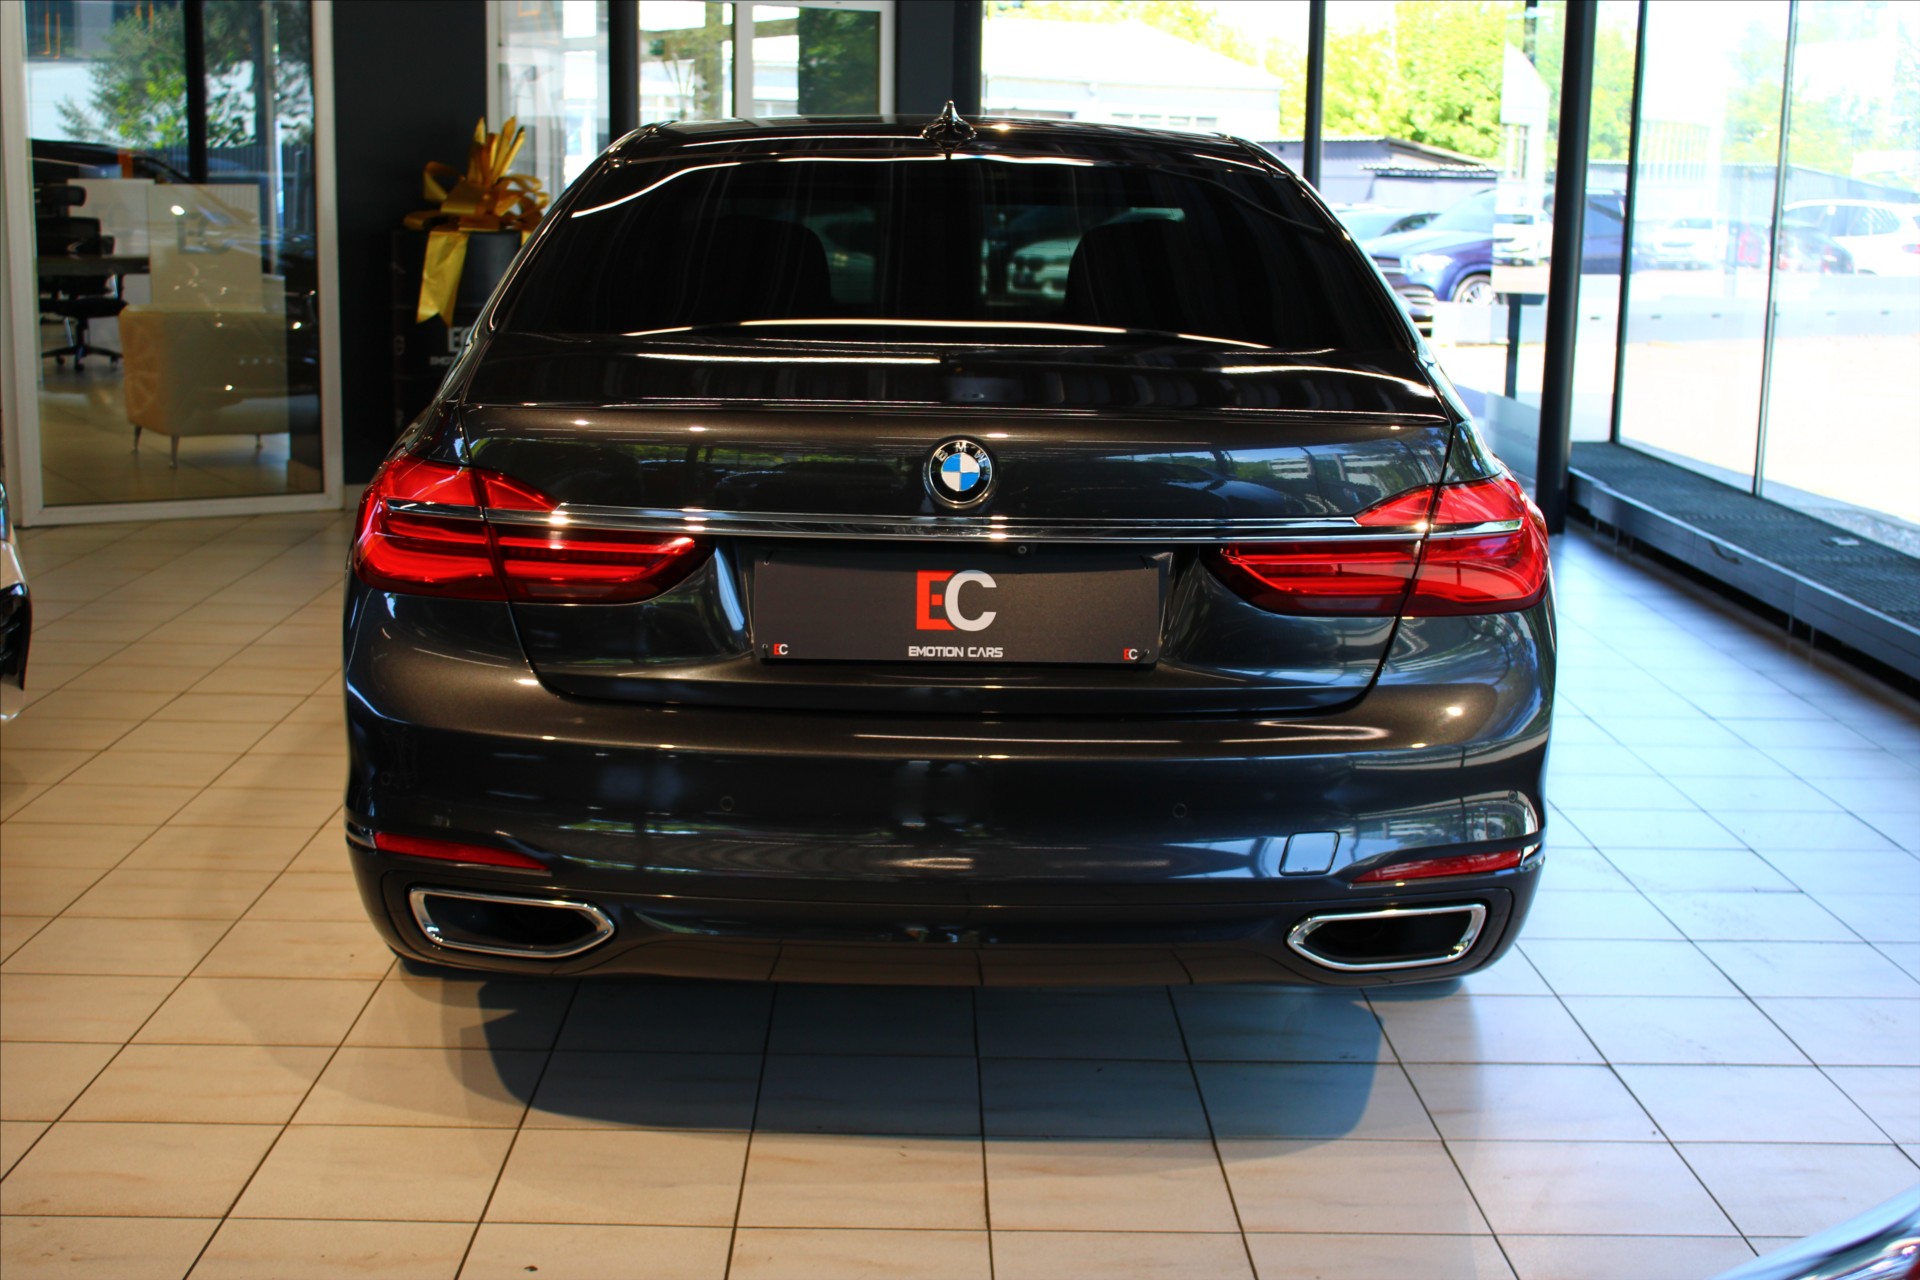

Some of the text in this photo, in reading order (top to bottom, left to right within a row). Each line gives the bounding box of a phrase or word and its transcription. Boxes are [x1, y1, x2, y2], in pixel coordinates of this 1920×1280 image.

[935, 441, 988, 463] BMW
[916, 569, 997, 632] EC
[774, 643, 789, 655] EC
[908, 645, 1004, 658] EMOTION CARS
[1123, 648, 1138, 660] EC
